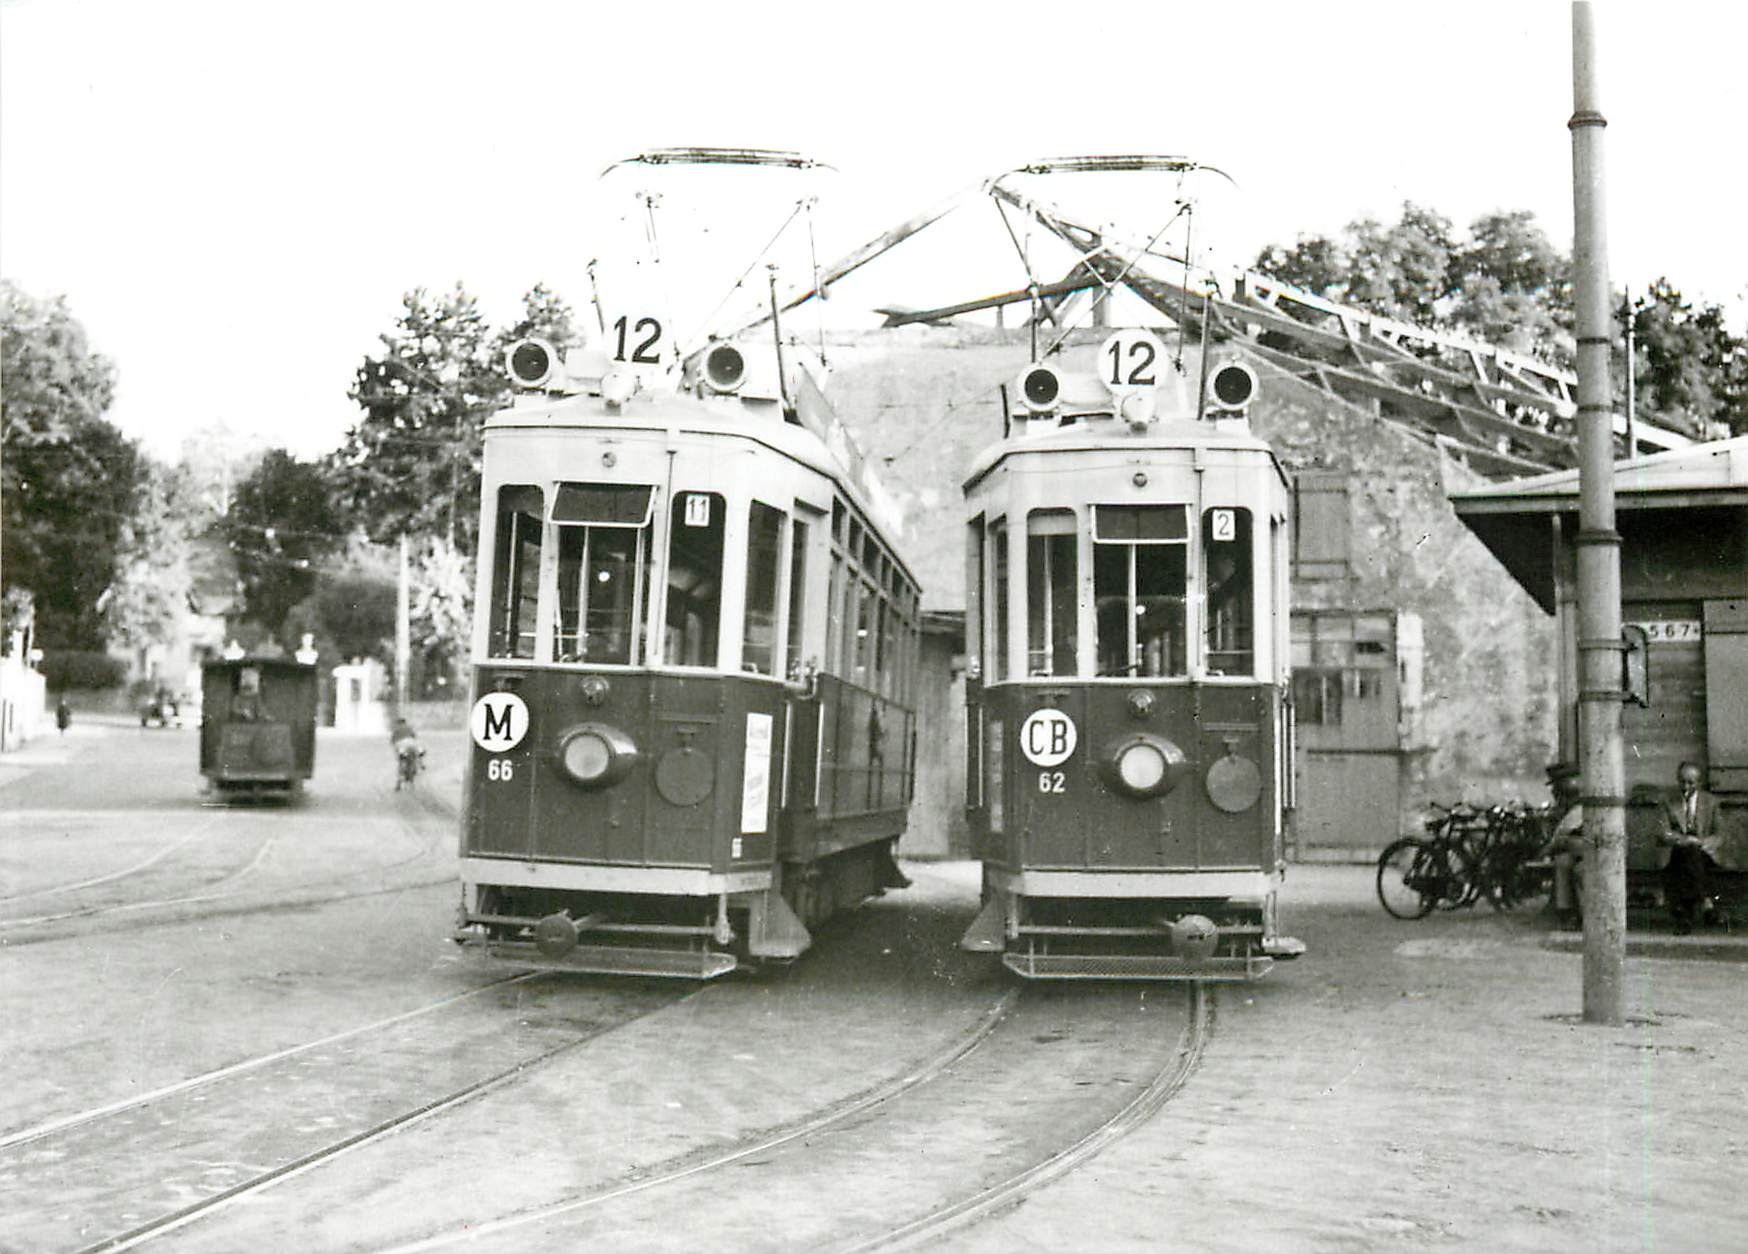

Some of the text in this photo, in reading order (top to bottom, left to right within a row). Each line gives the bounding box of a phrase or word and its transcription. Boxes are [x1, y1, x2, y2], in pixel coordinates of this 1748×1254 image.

[614, 315, 662, 364] 12
[1109, 340, 1156, 385] 12
[689, 497, 707, 522] 11
[1217, 513, 1230, 536] 2
[483, 703, 514, 741] M
[1029, 719, 1067, 756] CB
[488, 759, 513, 781] 66
[1039, 772, 1066, 793] 62
